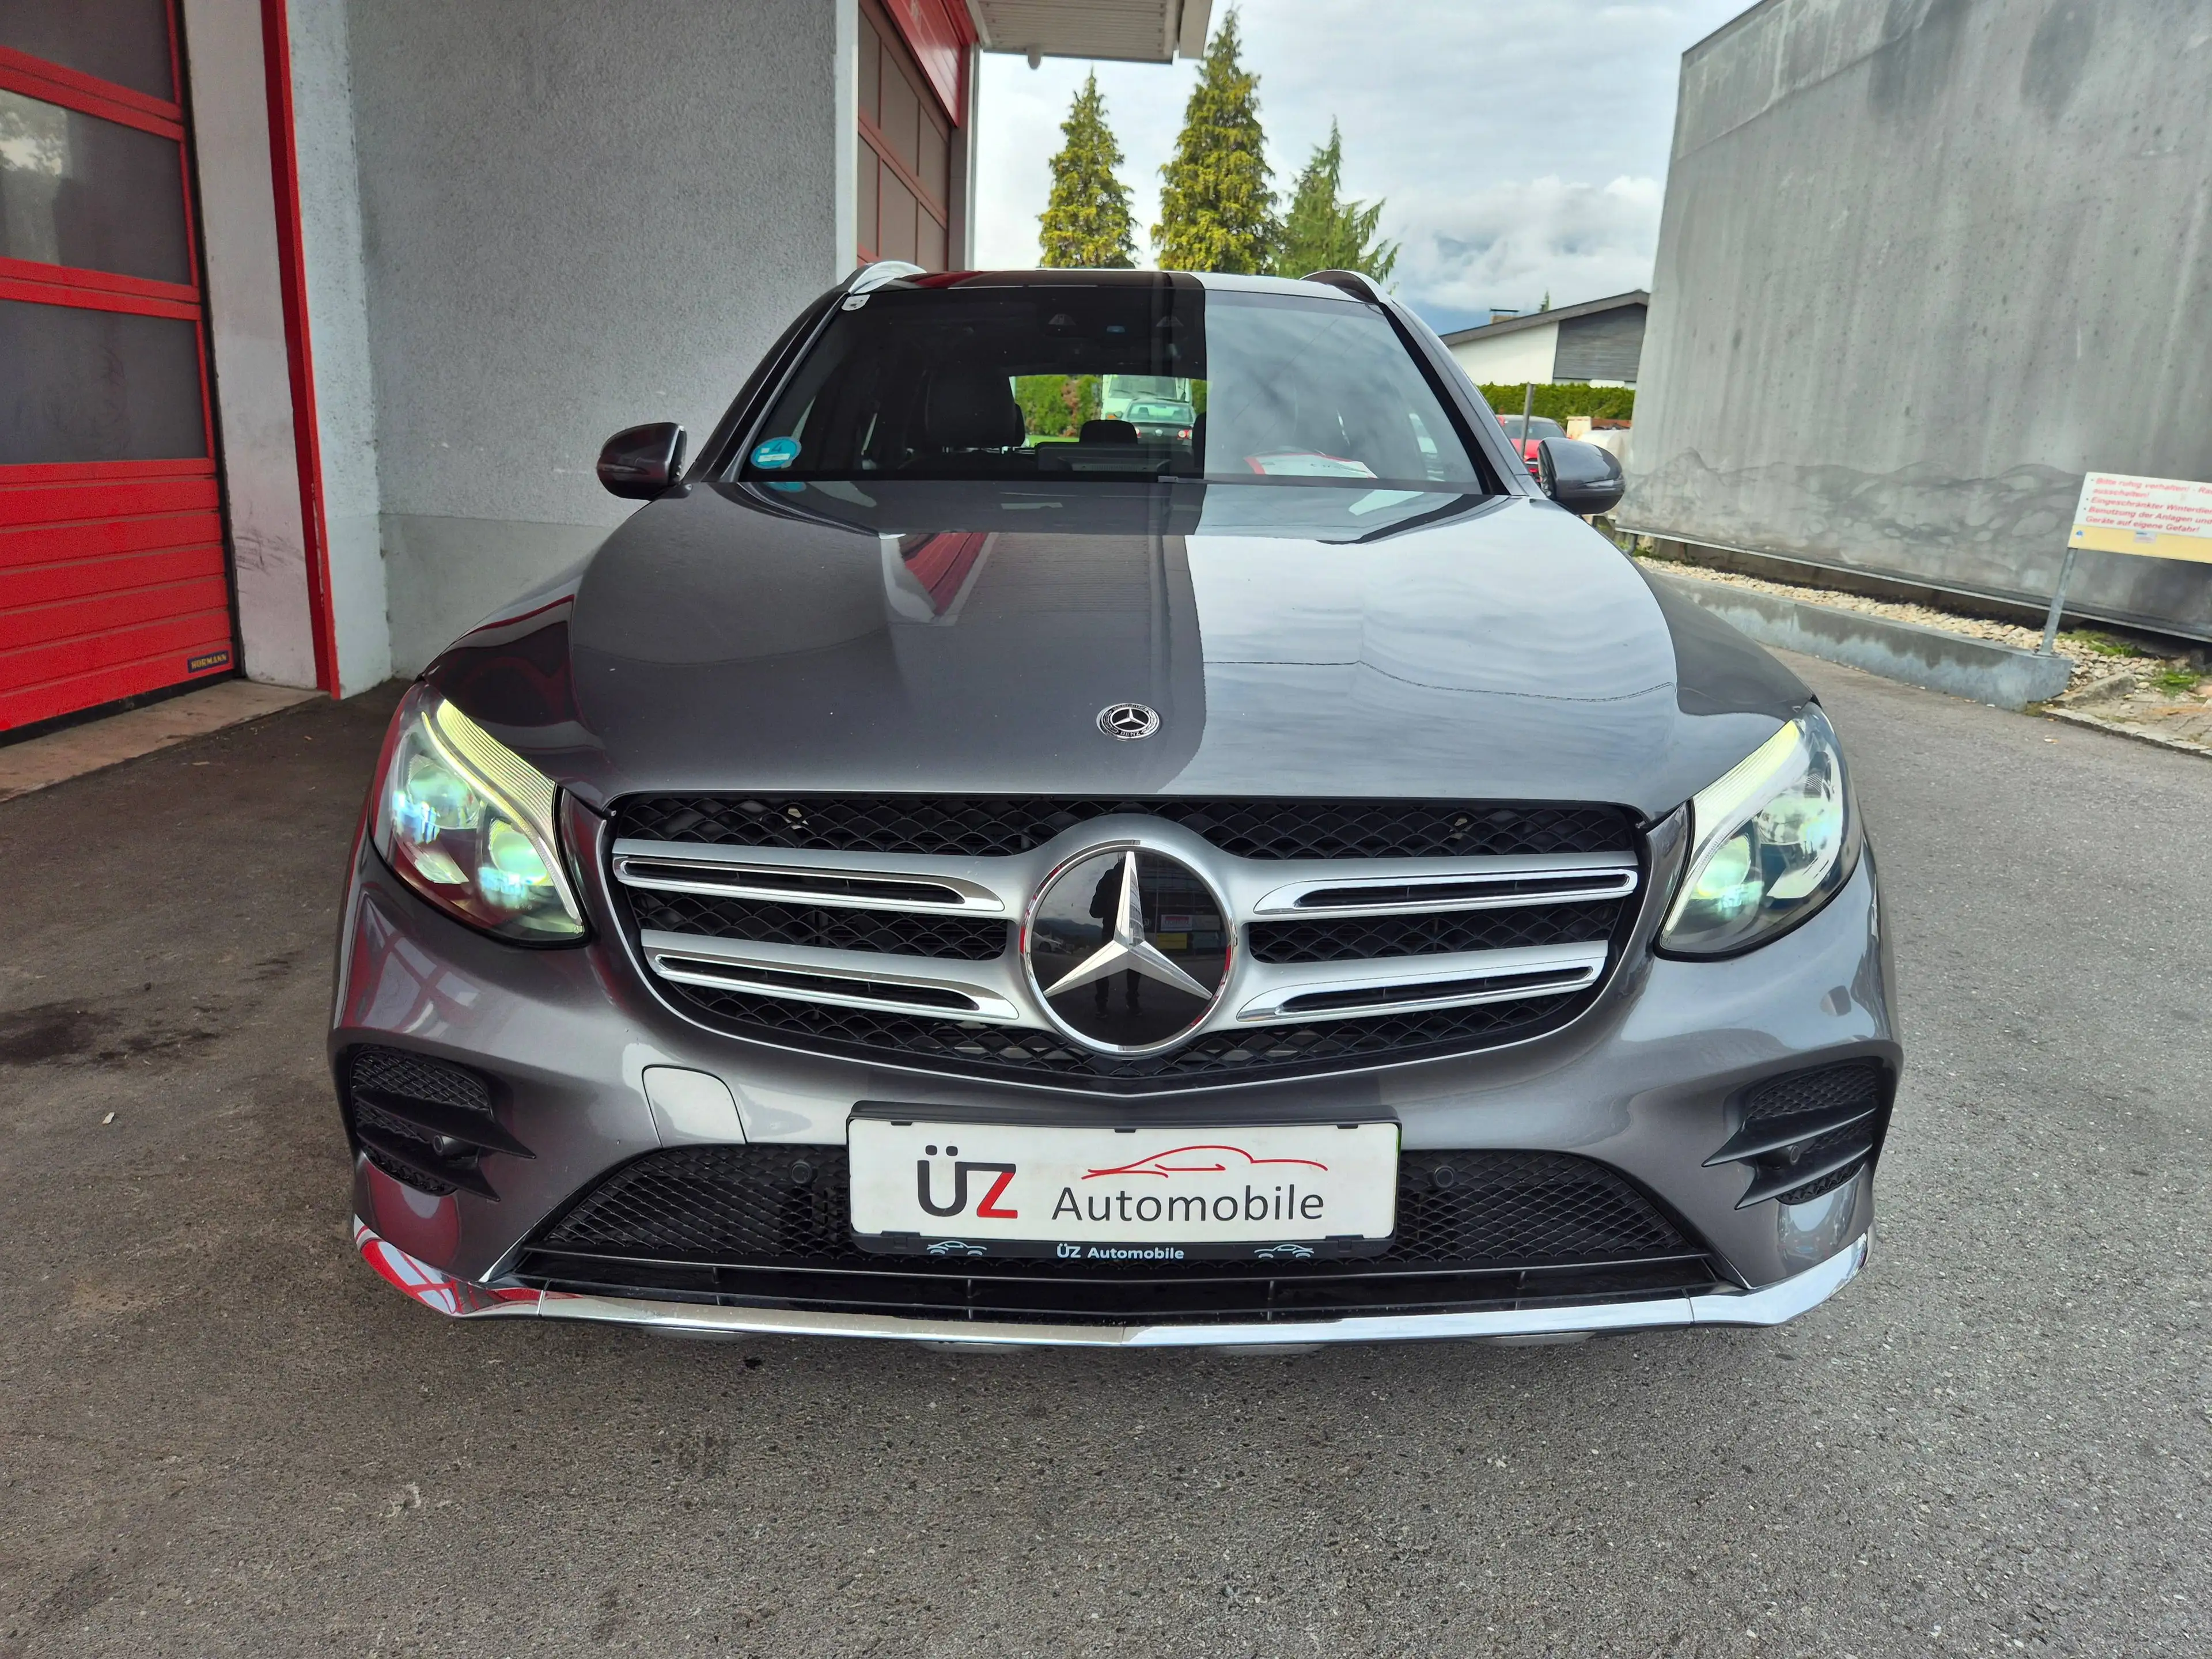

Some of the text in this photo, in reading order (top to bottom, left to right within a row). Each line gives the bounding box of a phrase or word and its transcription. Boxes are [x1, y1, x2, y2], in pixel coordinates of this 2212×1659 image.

[771, 441, 782, 453] 4
[2088, 506, 2136, 518] Benutzung
[2154, 513, 2192, 523] Anlagen
[2086, 516, 2115, 524] Geräte
[2133, 521, 2163, 529] eigene
[2166, 523, 2200, 532] Gefahr!
[917, 1145, 1324, 1222] ÜZ Automobile
[1056, 1243, 1184, 1260] ÜZ Automobile
